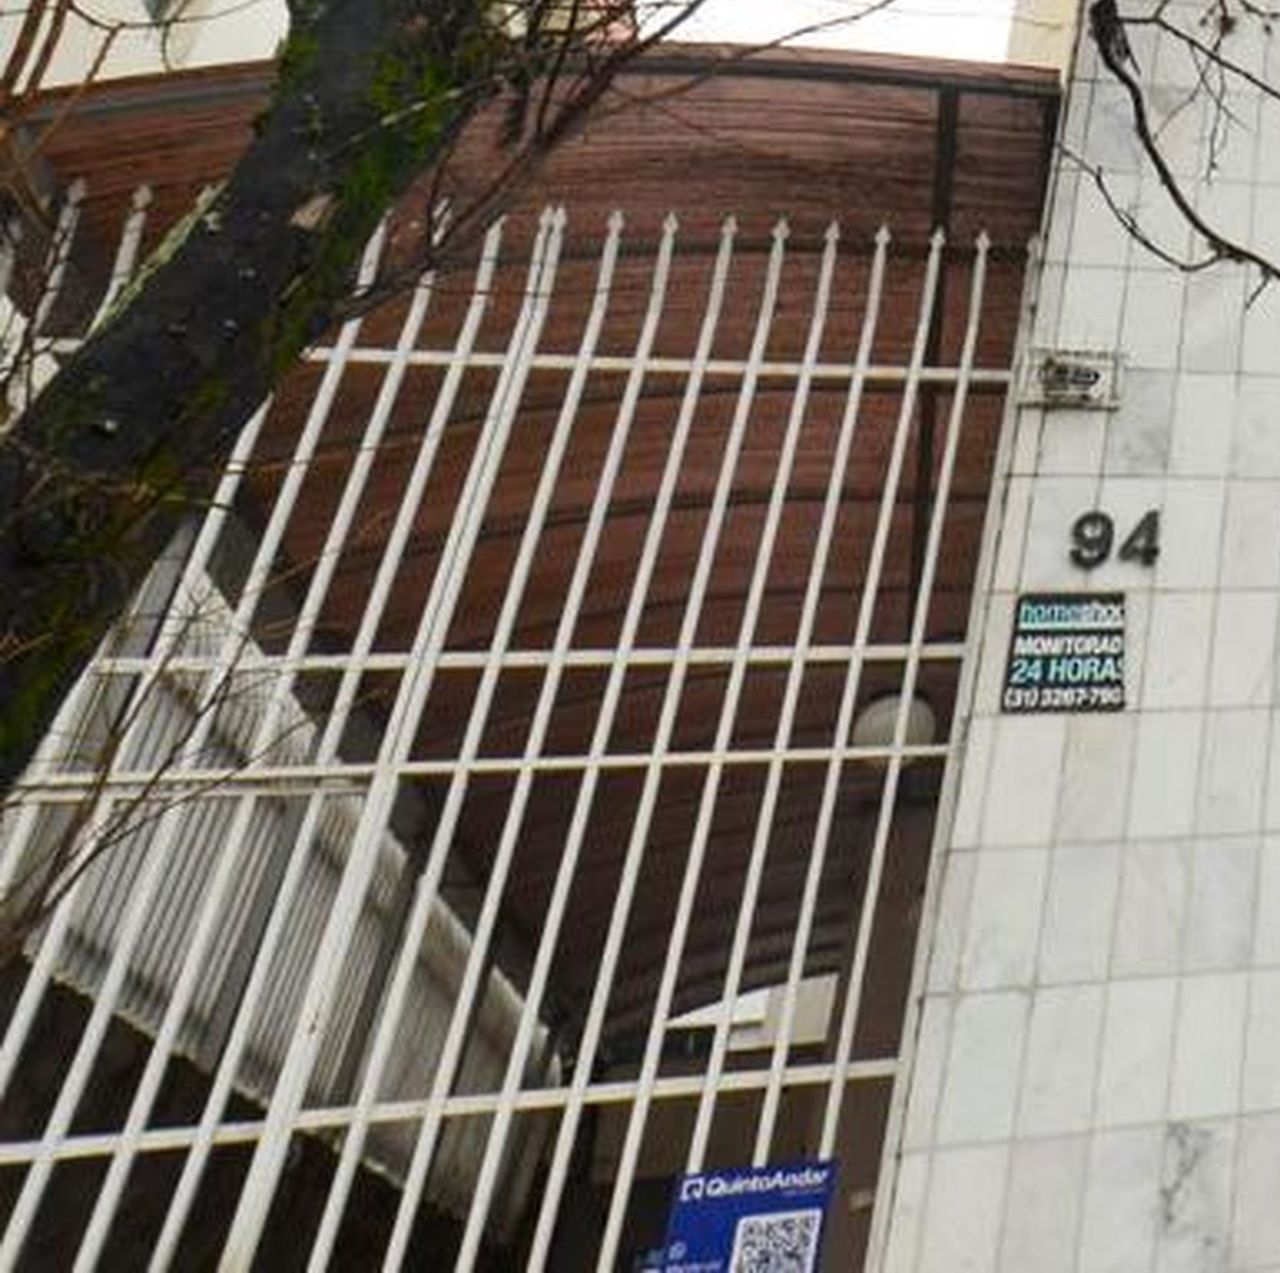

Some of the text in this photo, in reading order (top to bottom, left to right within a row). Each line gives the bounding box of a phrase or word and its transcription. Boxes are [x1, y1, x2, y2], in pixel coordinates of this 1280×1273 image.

[1068, 509, 1163, 573] 94
[1009, 658, 1042, 684] 24
[706, 1167, 829, 1198] QuintoAndar
